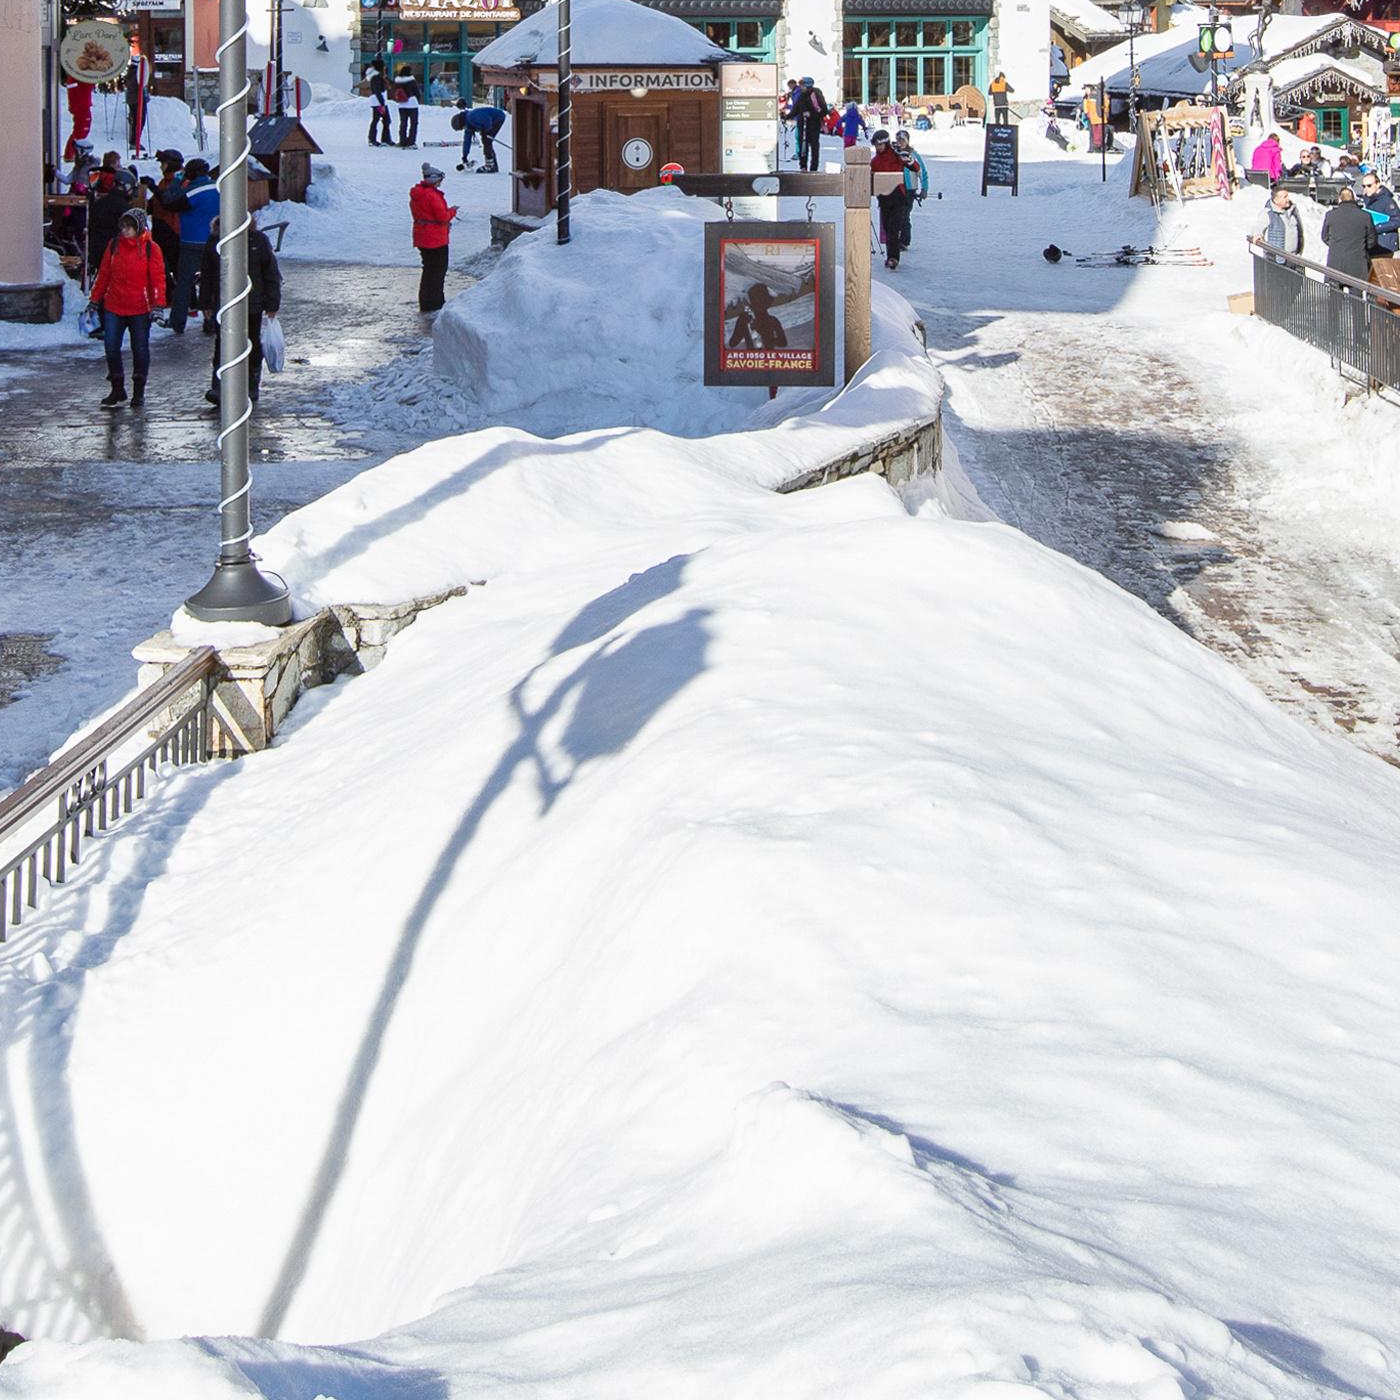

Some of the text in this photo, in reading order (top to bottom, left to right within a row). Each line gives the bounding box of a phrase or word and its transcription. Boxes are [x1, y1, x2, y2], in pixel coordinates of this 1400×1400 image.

[403, 10, 458, 18] RESTAURANT
[589, 74, 717, 89] INFORMATION
[726, 360, 812, 369] SAVOIE-FRANCE
